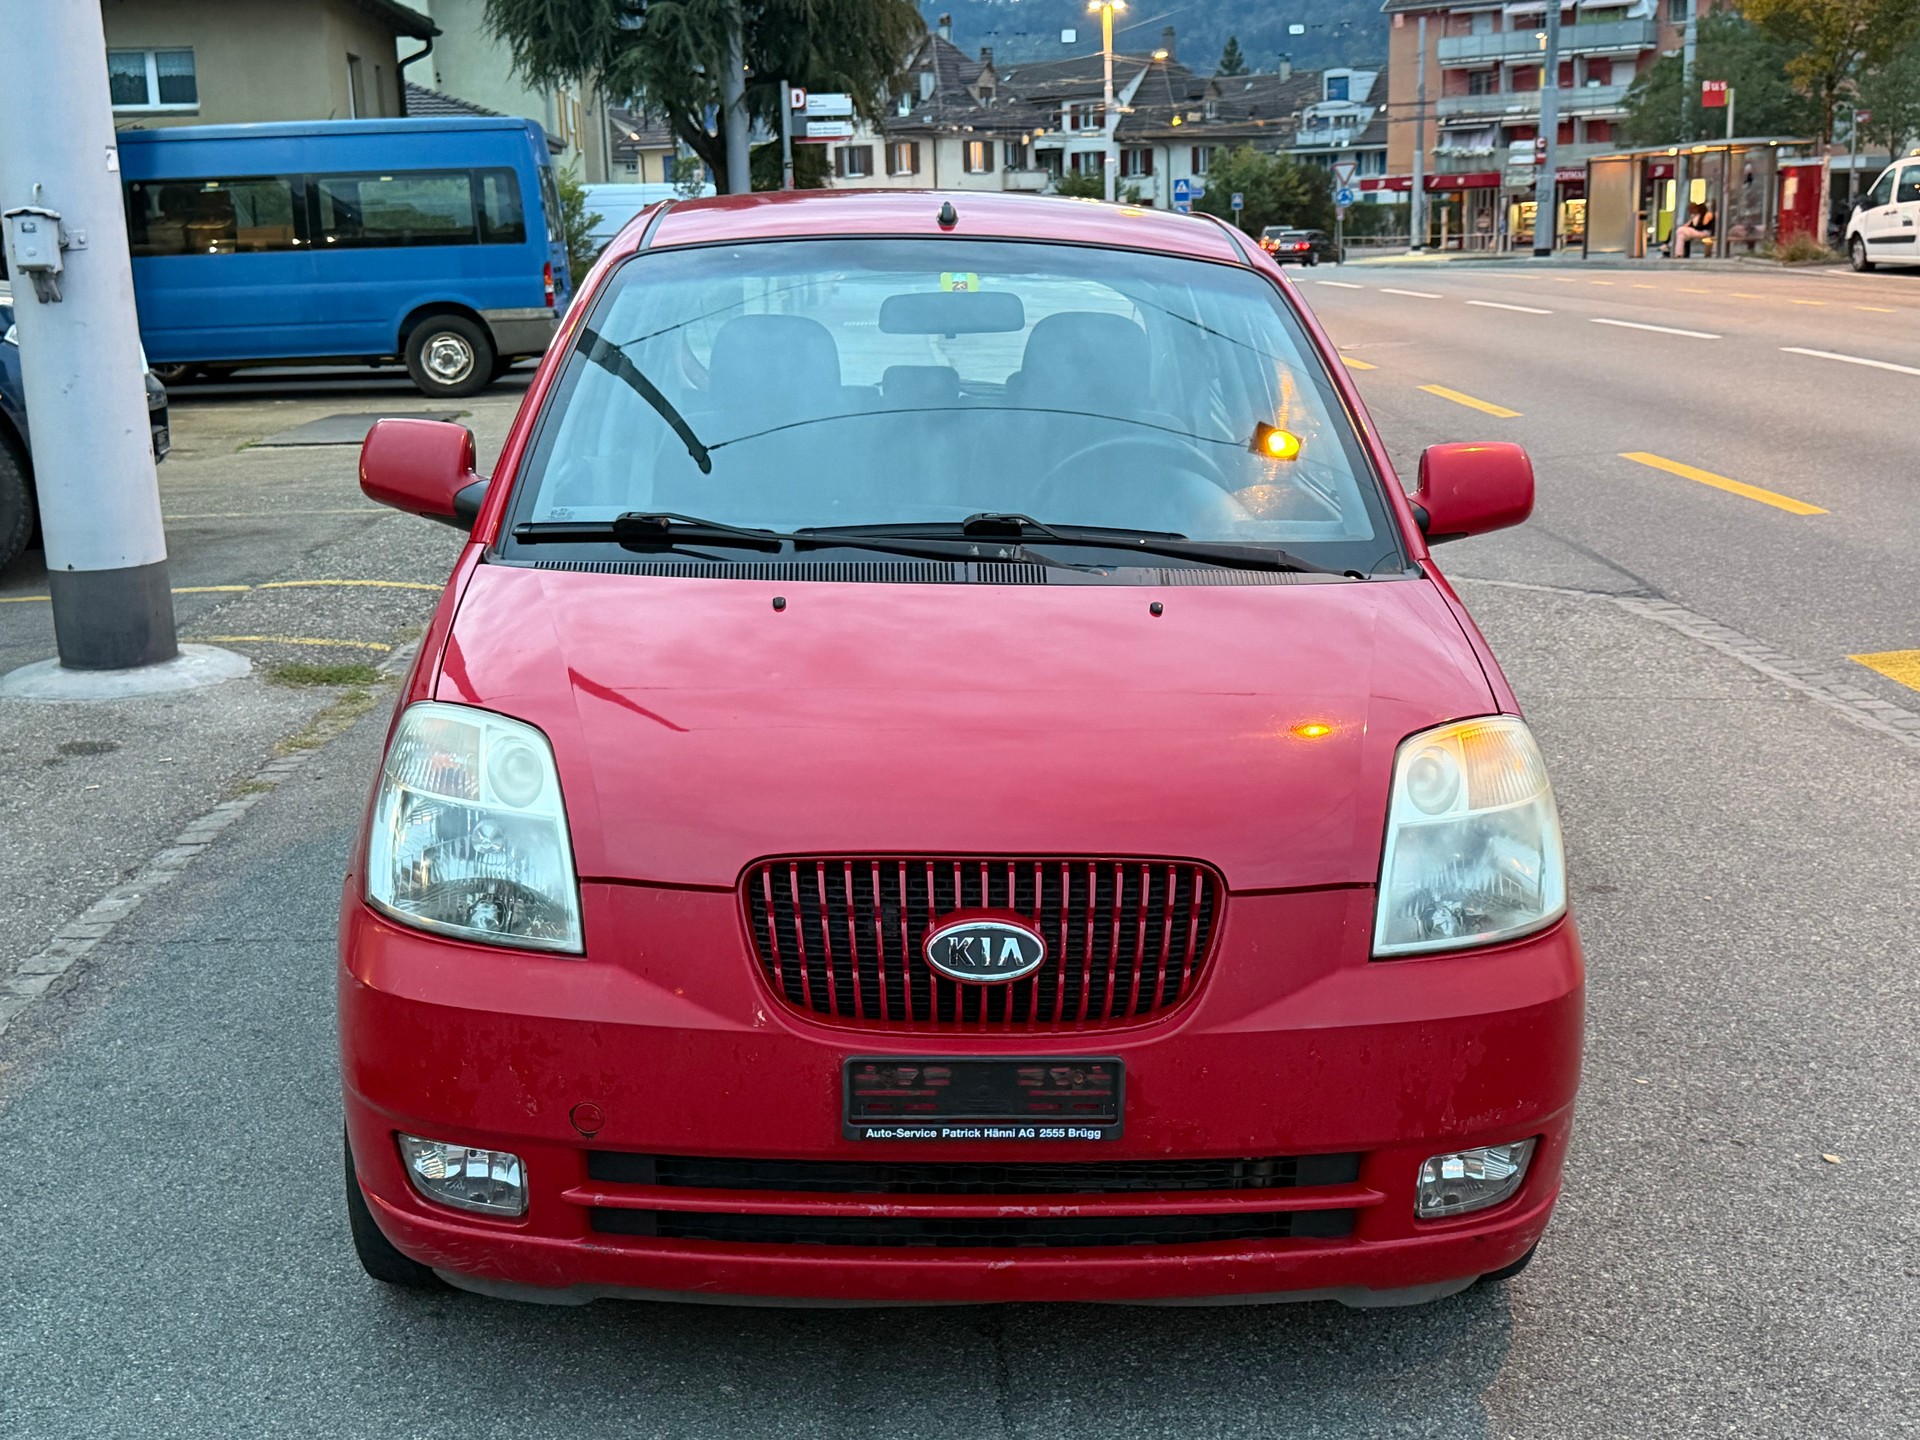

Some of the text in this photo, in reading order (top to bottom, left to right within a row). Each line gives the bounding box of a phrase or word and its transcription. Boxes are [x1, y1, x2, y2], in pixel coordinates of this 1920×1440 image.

[791, 89, 805, 108] D
[948, 937, 1025, 967] KIA
[865, 1128, 1102, 1140] Auto-Service Patrick Hänni AG 2555 Brügg
